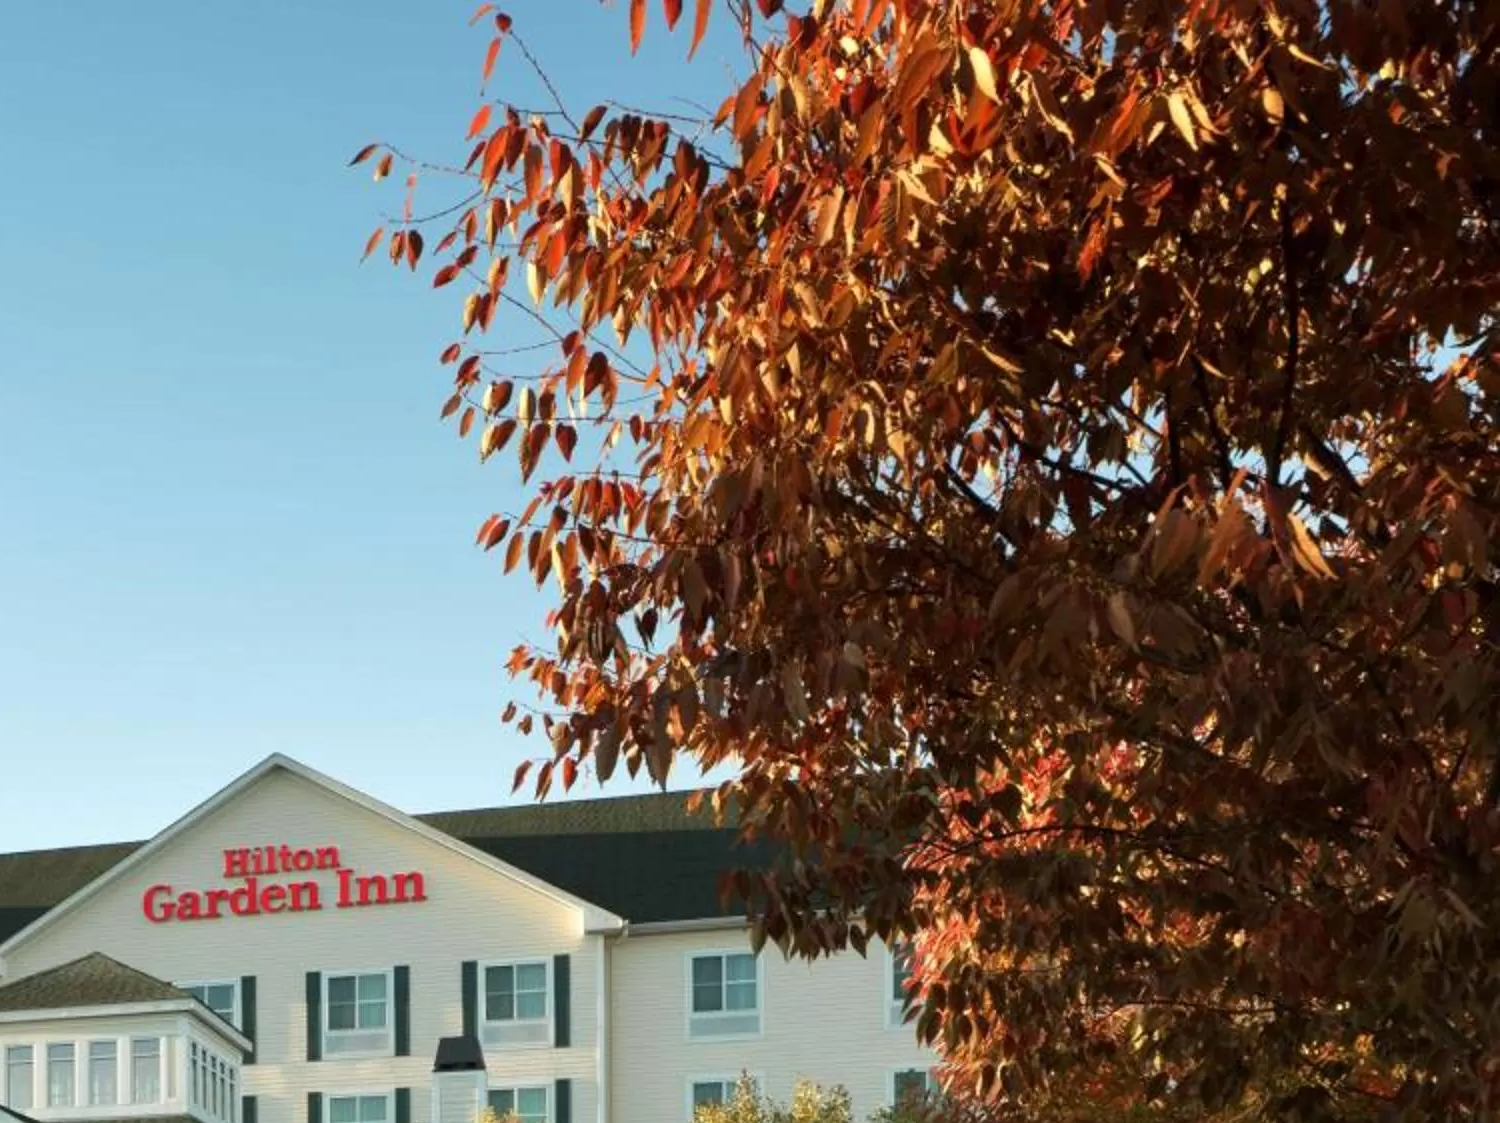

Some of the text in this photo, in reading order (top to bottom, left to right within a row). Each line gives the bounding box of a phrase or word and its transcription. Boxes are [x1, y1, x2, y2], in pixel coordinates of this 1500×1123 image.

[223, 844, 340, 878] Hilton
[143, 868, 427, 924] Garden Inn
